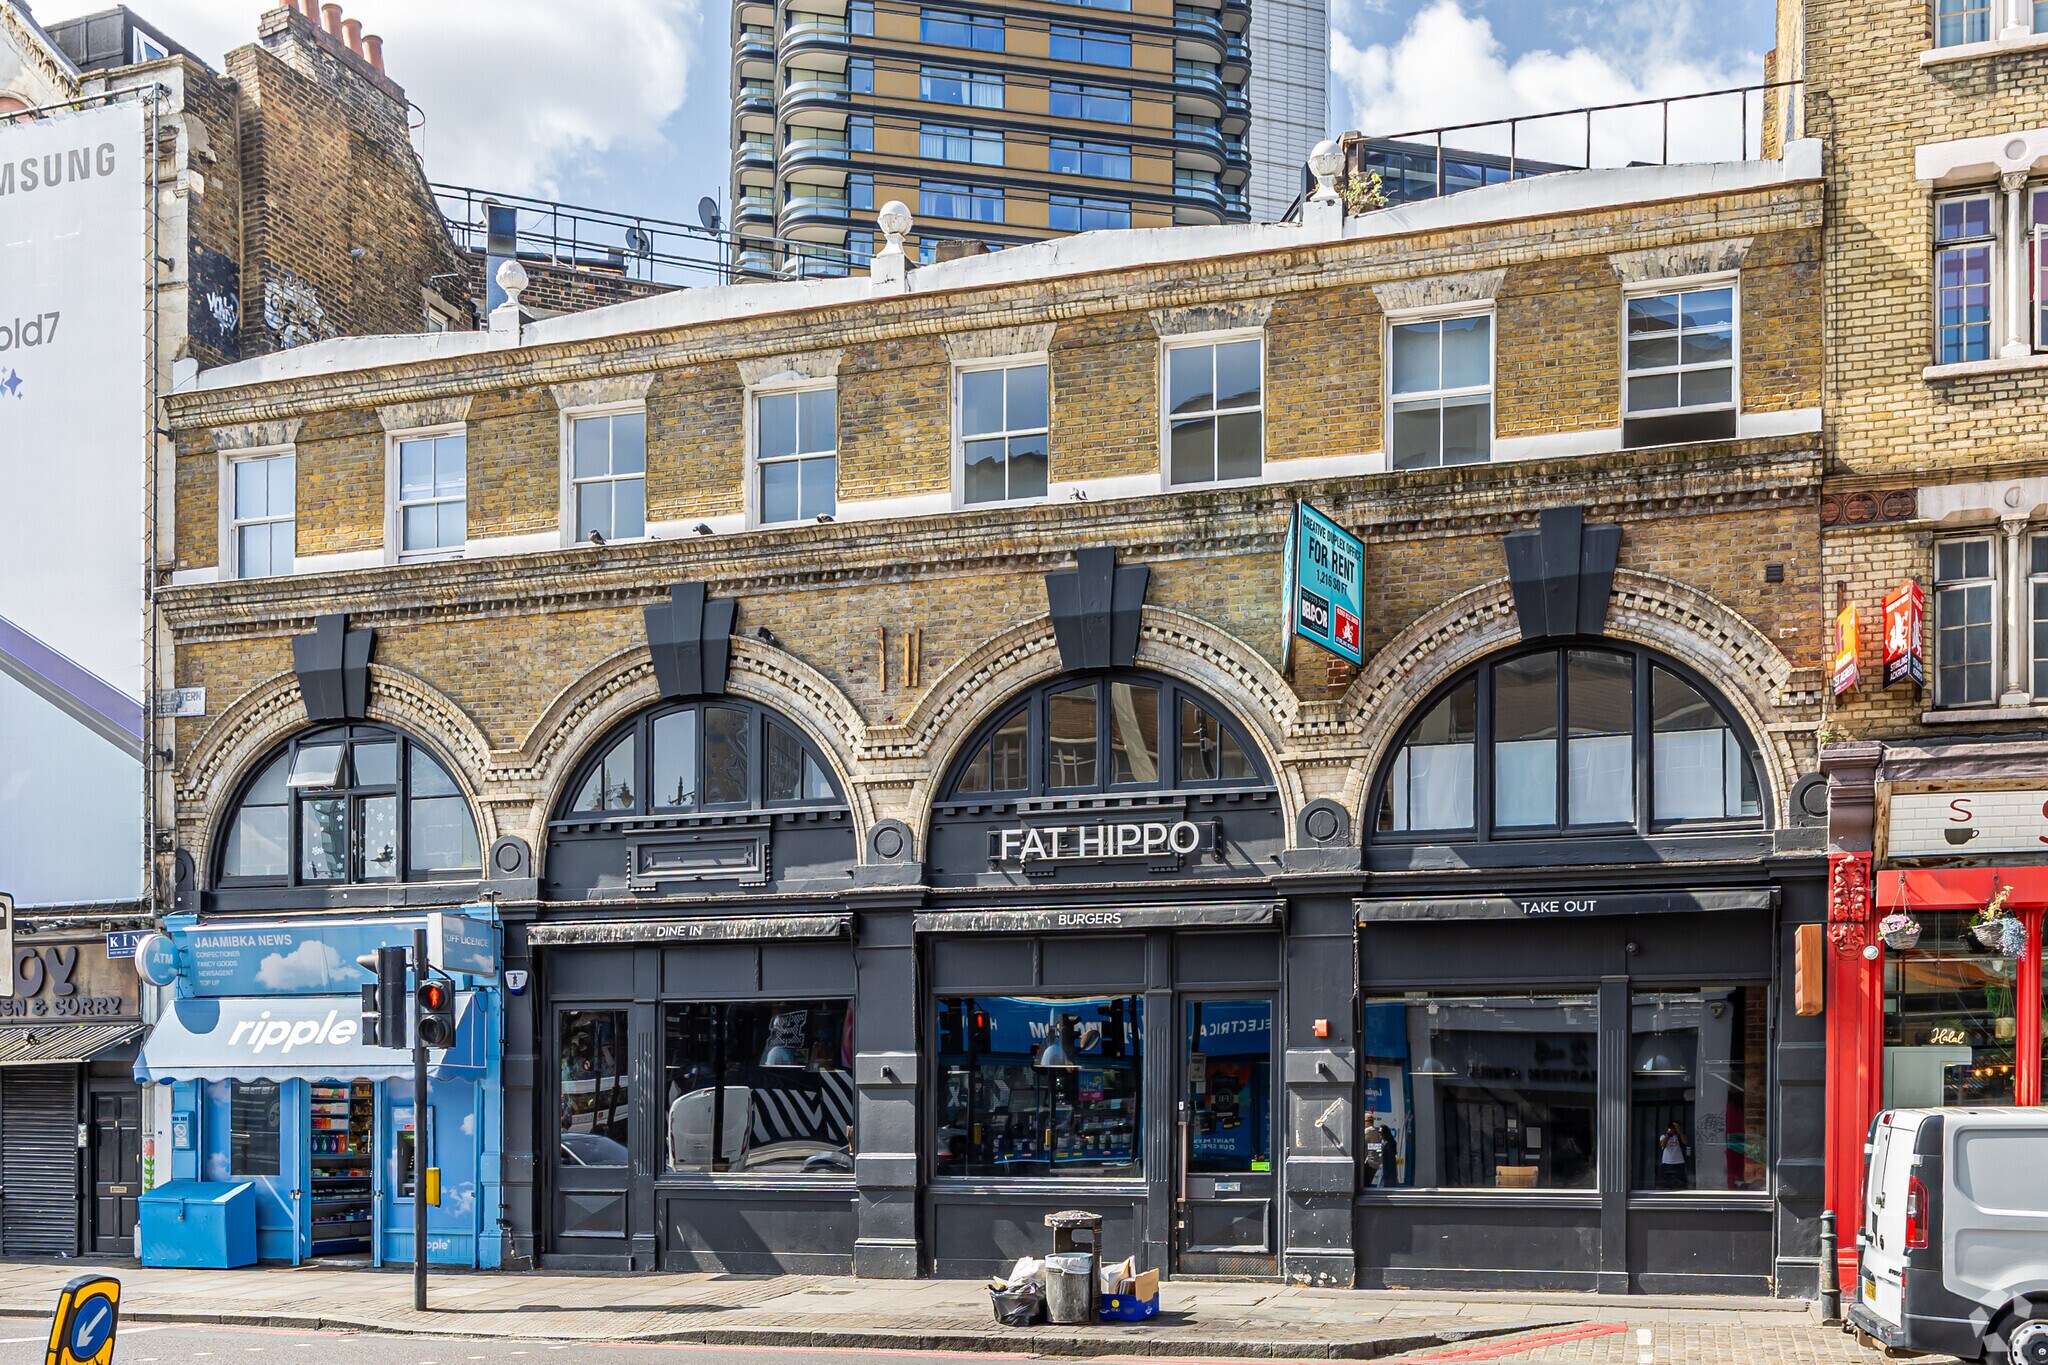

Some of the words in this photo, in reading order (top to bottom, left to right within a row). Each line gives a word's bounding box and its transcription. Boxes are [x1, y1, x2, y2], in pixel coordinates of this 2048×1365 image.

[1303, 514, 1326, 539] CREATIVE
[1346, 543, 1362, 563] OFFICE
[1309, 536, 1328, 569] FOR
[1332, 550, 1355, 585] RENT
[1331, 576, 1341, 593] SQ
[1341, 582, 1348, 596] FT
[1001, 826, 1068, 860] FAT
[1079, 820, 1200, 857] HIPPO
[1521, 900, 1560, 914] TAKE
[1564, 899, 1597, 913] OUT
[1058, 912, 1122, 925] BURGERS
[656, 925, 686, 938] DINE
[689, 924, 702, 937] IN
[258, 933, 293, 946] NEWS
[446, 933, 460, 943] OFF
[460, 936, 489, 948] LICENCE
[153, 952, 174, 965] ATM
[196, 950, 241, 959] CONFECTIONER
[200, 979, 211, 987] TOP
[33, 998, 49, 1016] &
[54, 996, 121, 1016] CURRY
[228, 1009, 357, 1054] ripple
[1931, 1027, 1965, 1044] Halal
